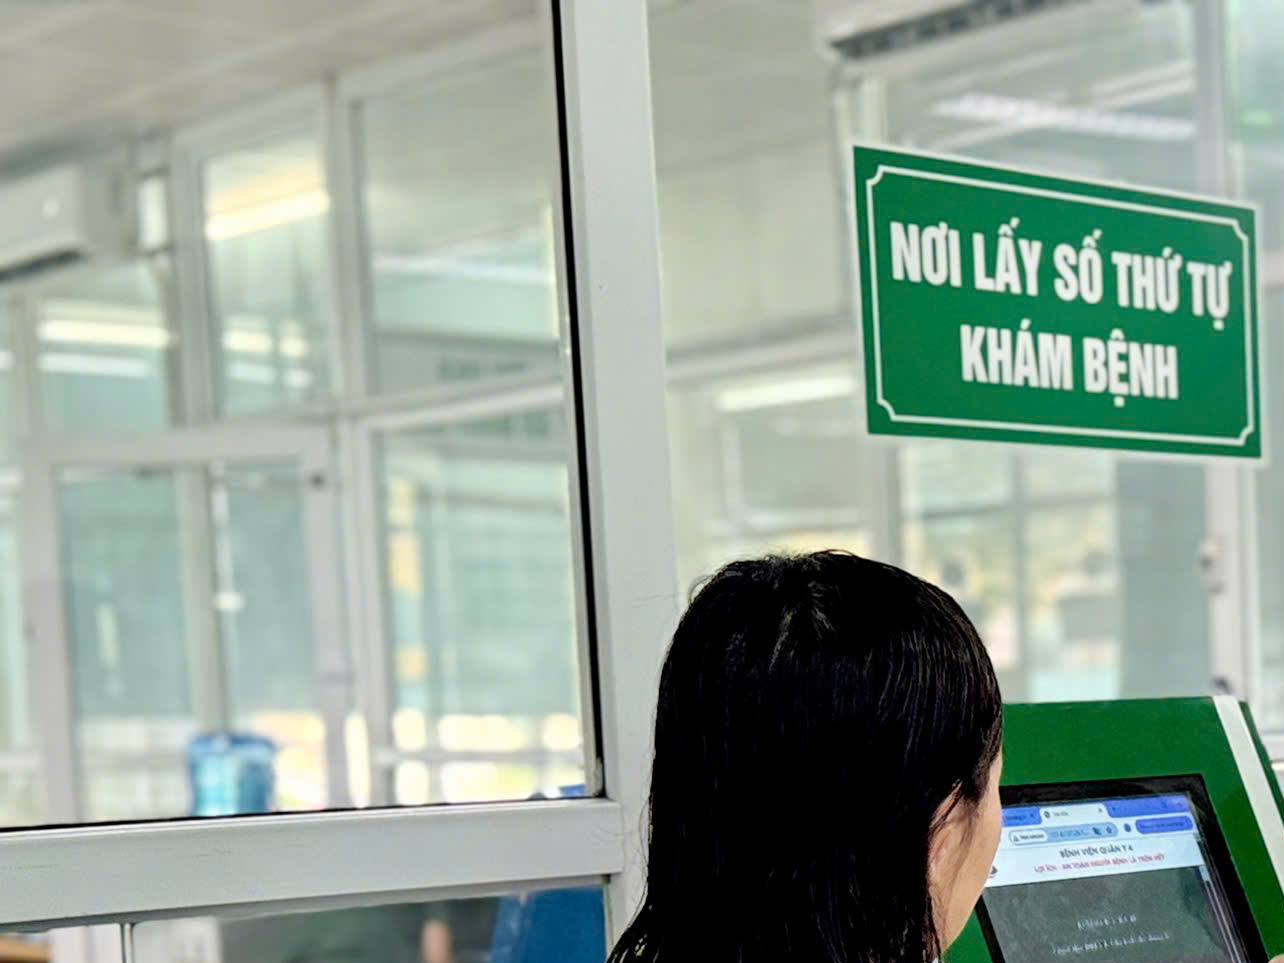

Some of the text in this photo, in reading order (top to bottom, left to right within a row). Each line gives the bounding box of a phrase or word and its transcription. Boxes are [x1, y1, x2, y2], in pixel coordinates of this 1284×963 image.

[890, 217, 1232, 331] NƠI LẤY SỐ THỨ TỰ
[960, 318, 1179, 408] KHÁM BỆNH
